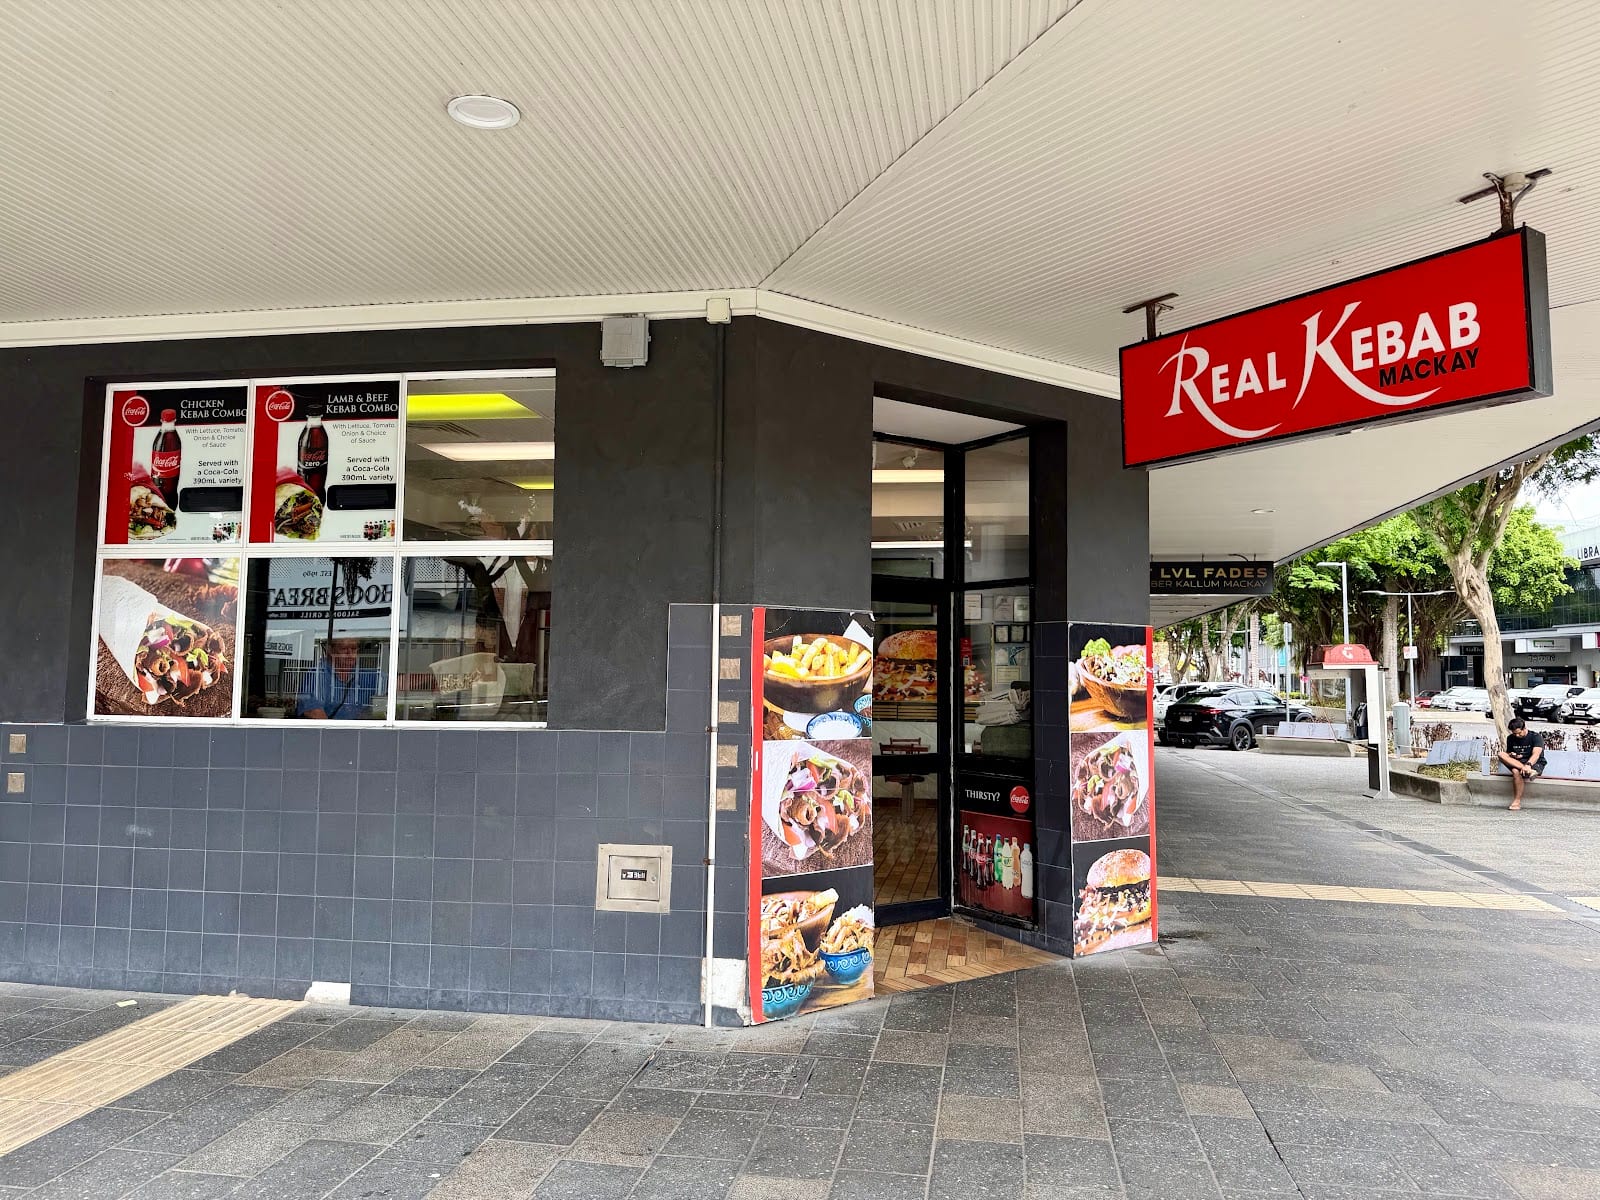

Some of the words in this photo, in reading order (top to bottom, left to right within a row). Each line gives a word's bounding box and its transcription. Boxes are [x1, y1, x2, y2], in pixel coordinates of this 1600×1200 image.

[1378, 347, 1480, 388] MACKAY
[356, 394, 364, 403] &
[347, 456, 372, 464] Served
[193, 477, 217, 485] 390mL
[218, 477, 242, 485] variety
[369, 473, 394, 481] variety
[1160, 567, 1196, 579] LVL
[1203, 567, 1268, 579] FADES
[1175, 580, 1220, 588] KALLUM
[1223, 580, 1268, 588] MACKAY
[964, 789, 1001, 802] THIRSTY?
